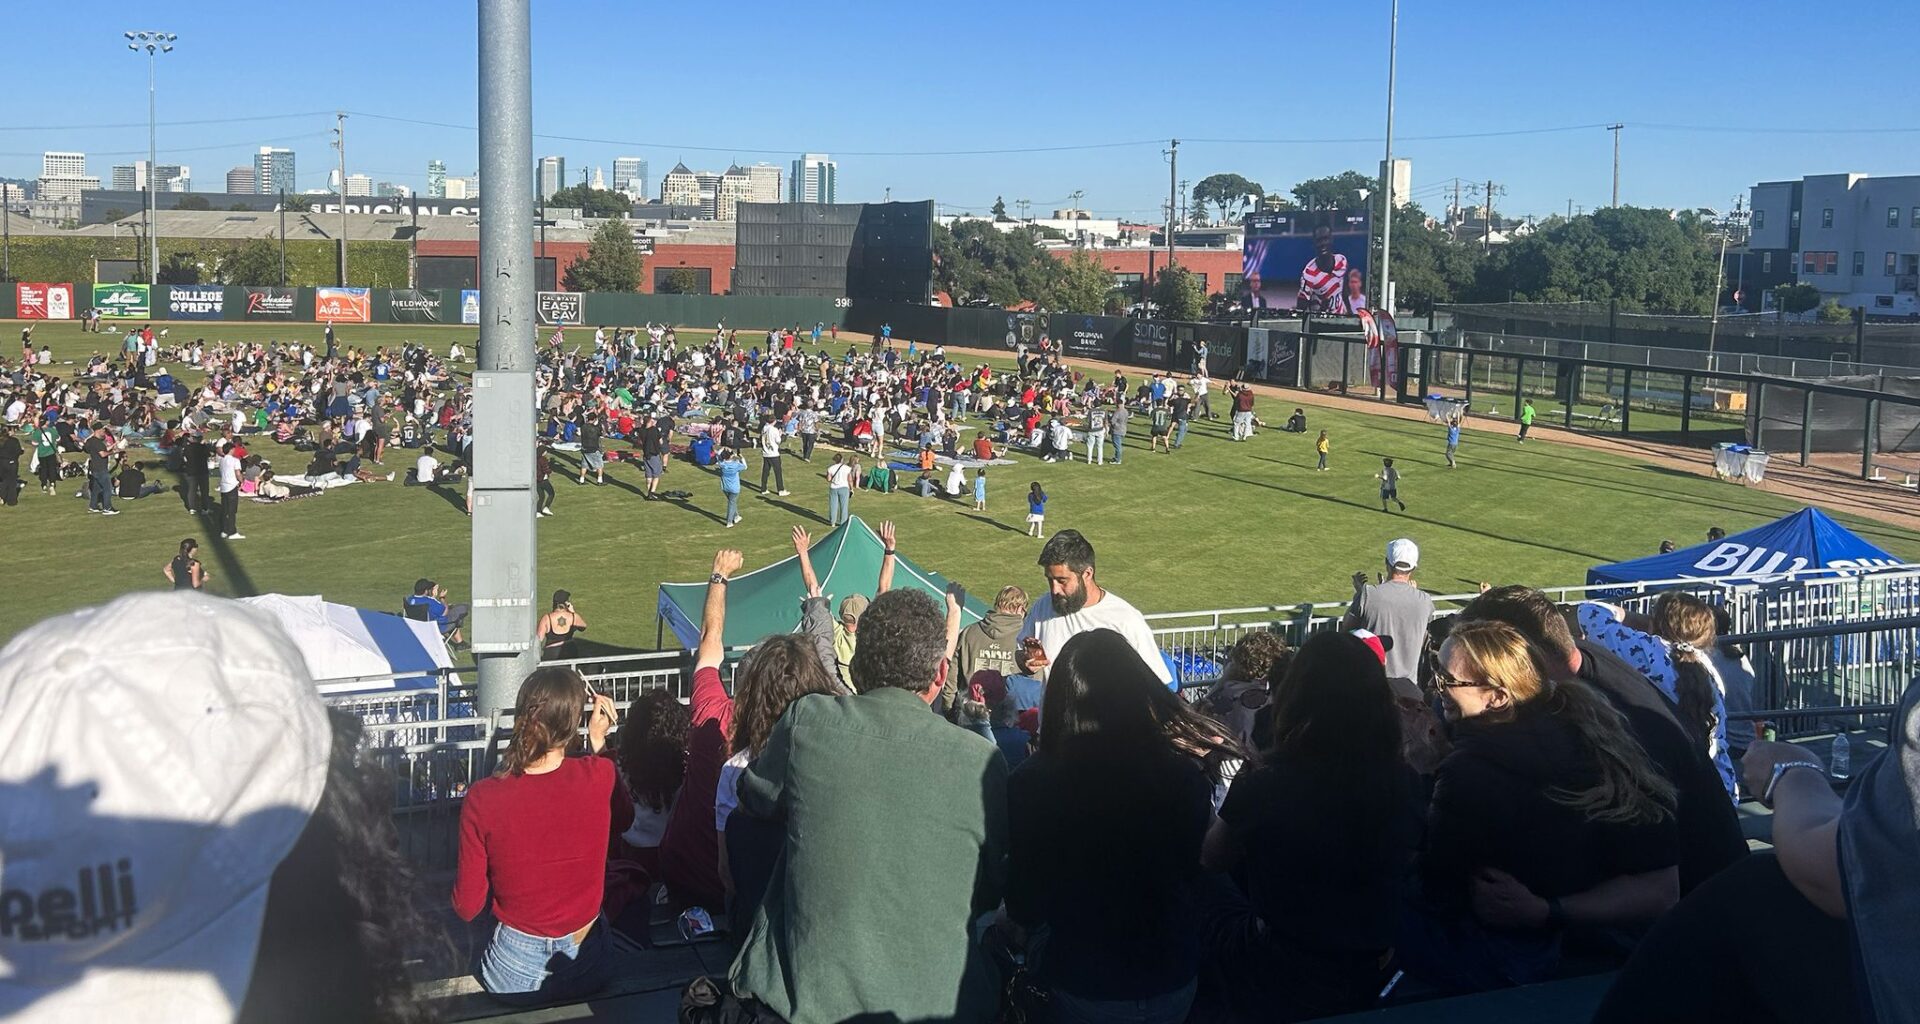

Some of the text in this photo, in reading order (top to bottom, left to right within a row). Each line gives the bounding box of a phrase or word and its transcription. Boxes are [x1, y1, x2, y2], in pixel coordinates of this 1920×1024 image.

[169, 291, 224, 302] COLLEGE
[180, 302, 213, 313] PREP
[391, 300, 440, 308] FIELDWORK
[541, 301, 577, 311] EAST
[834, 297, 853, 308] 398
[319, 305, 341, 315] Ava
[551, 310, 577, 320] BAY
[403, 430, 413, 439] 10
[1033, 432, 1039, 441] 7
